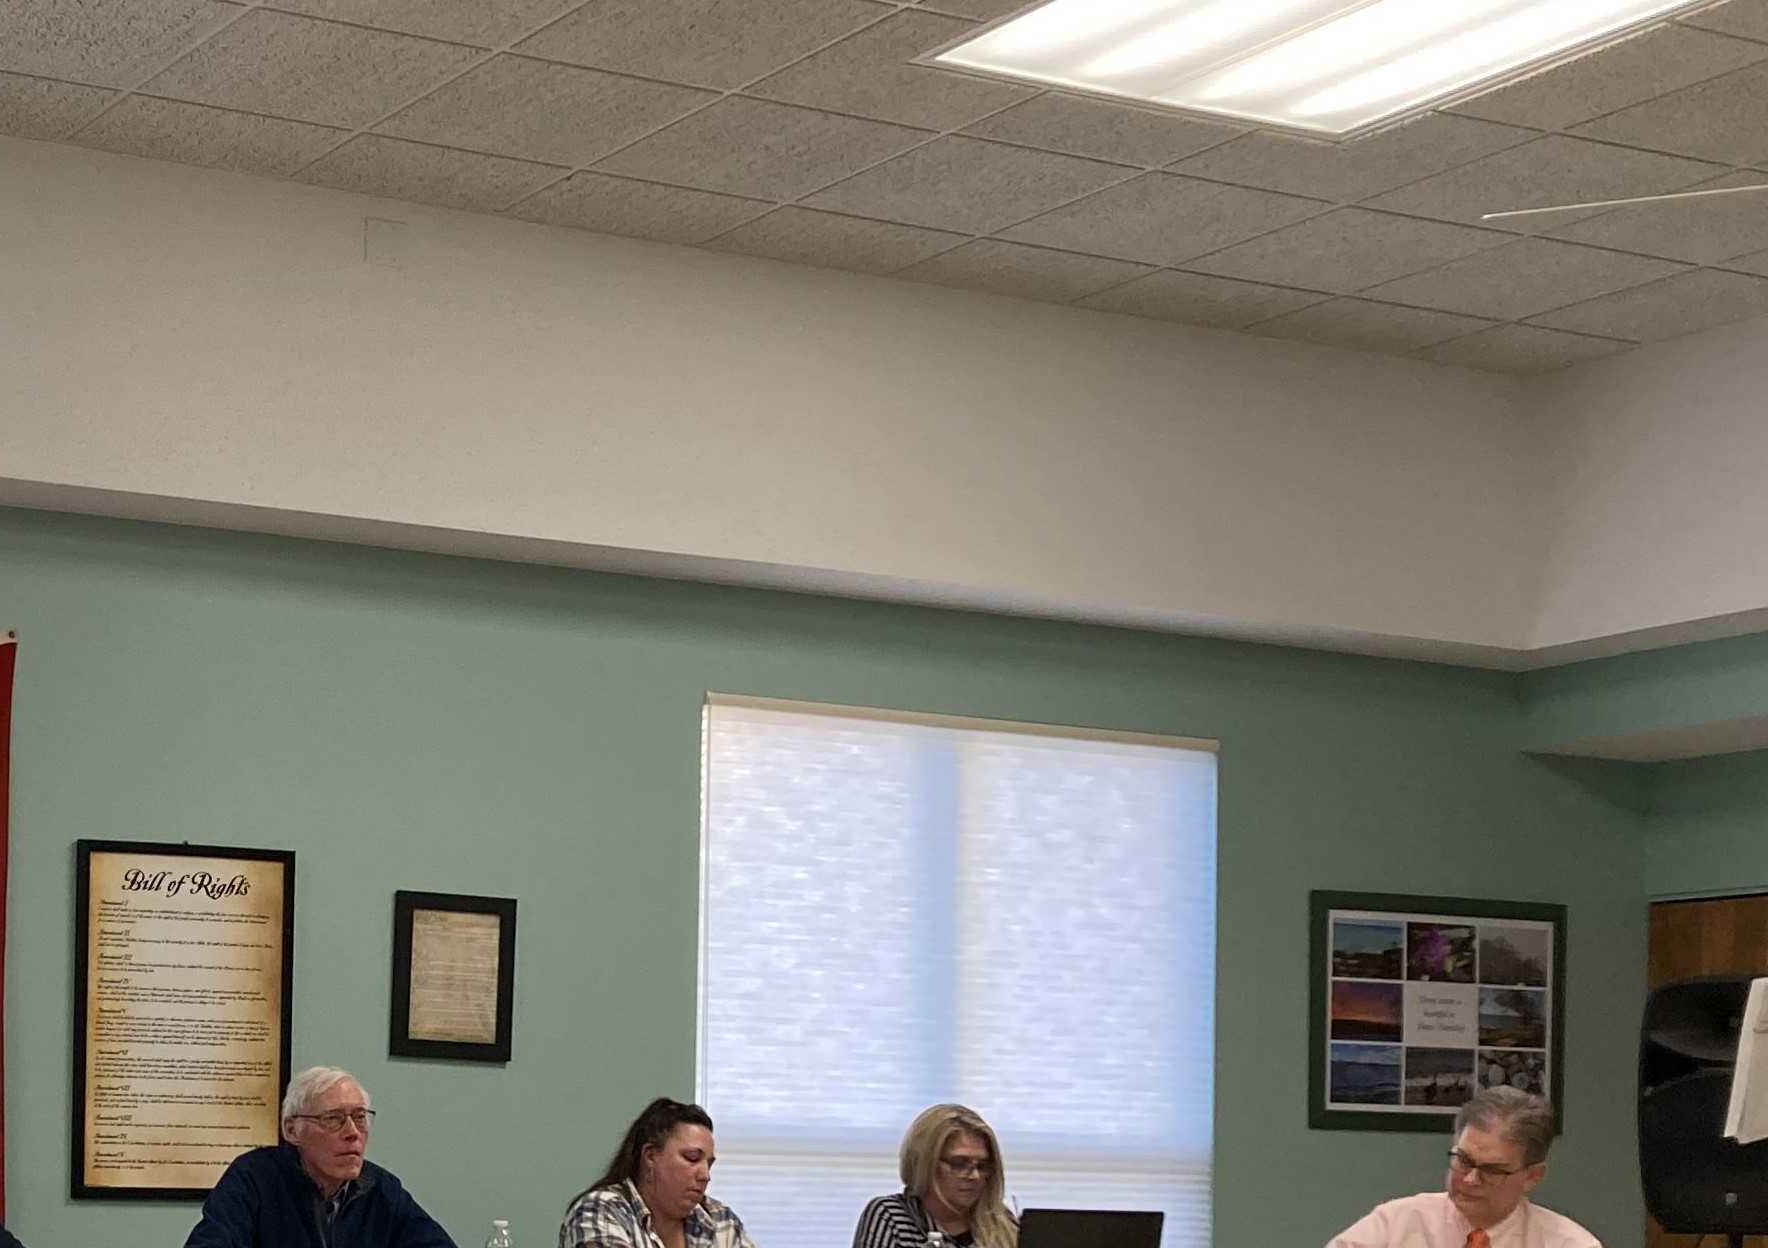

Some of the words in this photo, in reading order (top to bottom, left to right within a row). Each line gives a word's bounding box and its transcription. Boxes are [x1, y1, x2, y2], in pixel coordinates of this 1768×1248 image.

[121, 868, 170, 892] Bill
[166, 874, 190, 898] of
[189, 871, 252, 900] Rights
